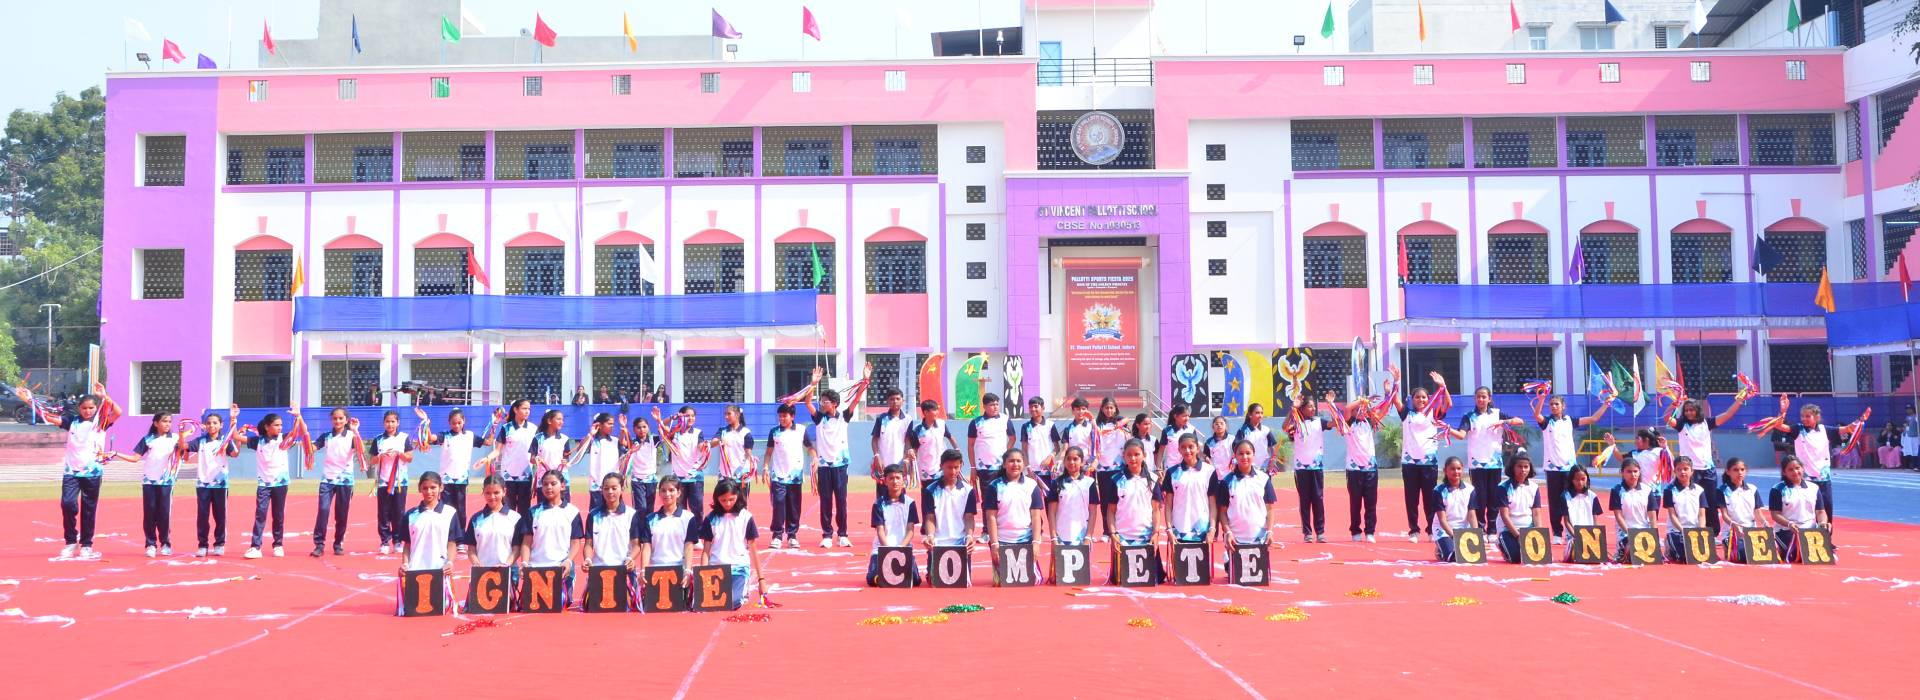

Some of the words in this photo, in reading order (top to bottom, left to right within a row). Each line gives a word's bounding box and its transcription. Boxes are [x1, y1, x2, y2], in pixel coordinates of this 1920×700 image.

[1056, 221, 1085, 231] CBSE
[1459, 527, 1832, 564] CONQUER
[881, 547, 1263, 586] COMPETE
[415, 568, 728, 614] IGNITE
